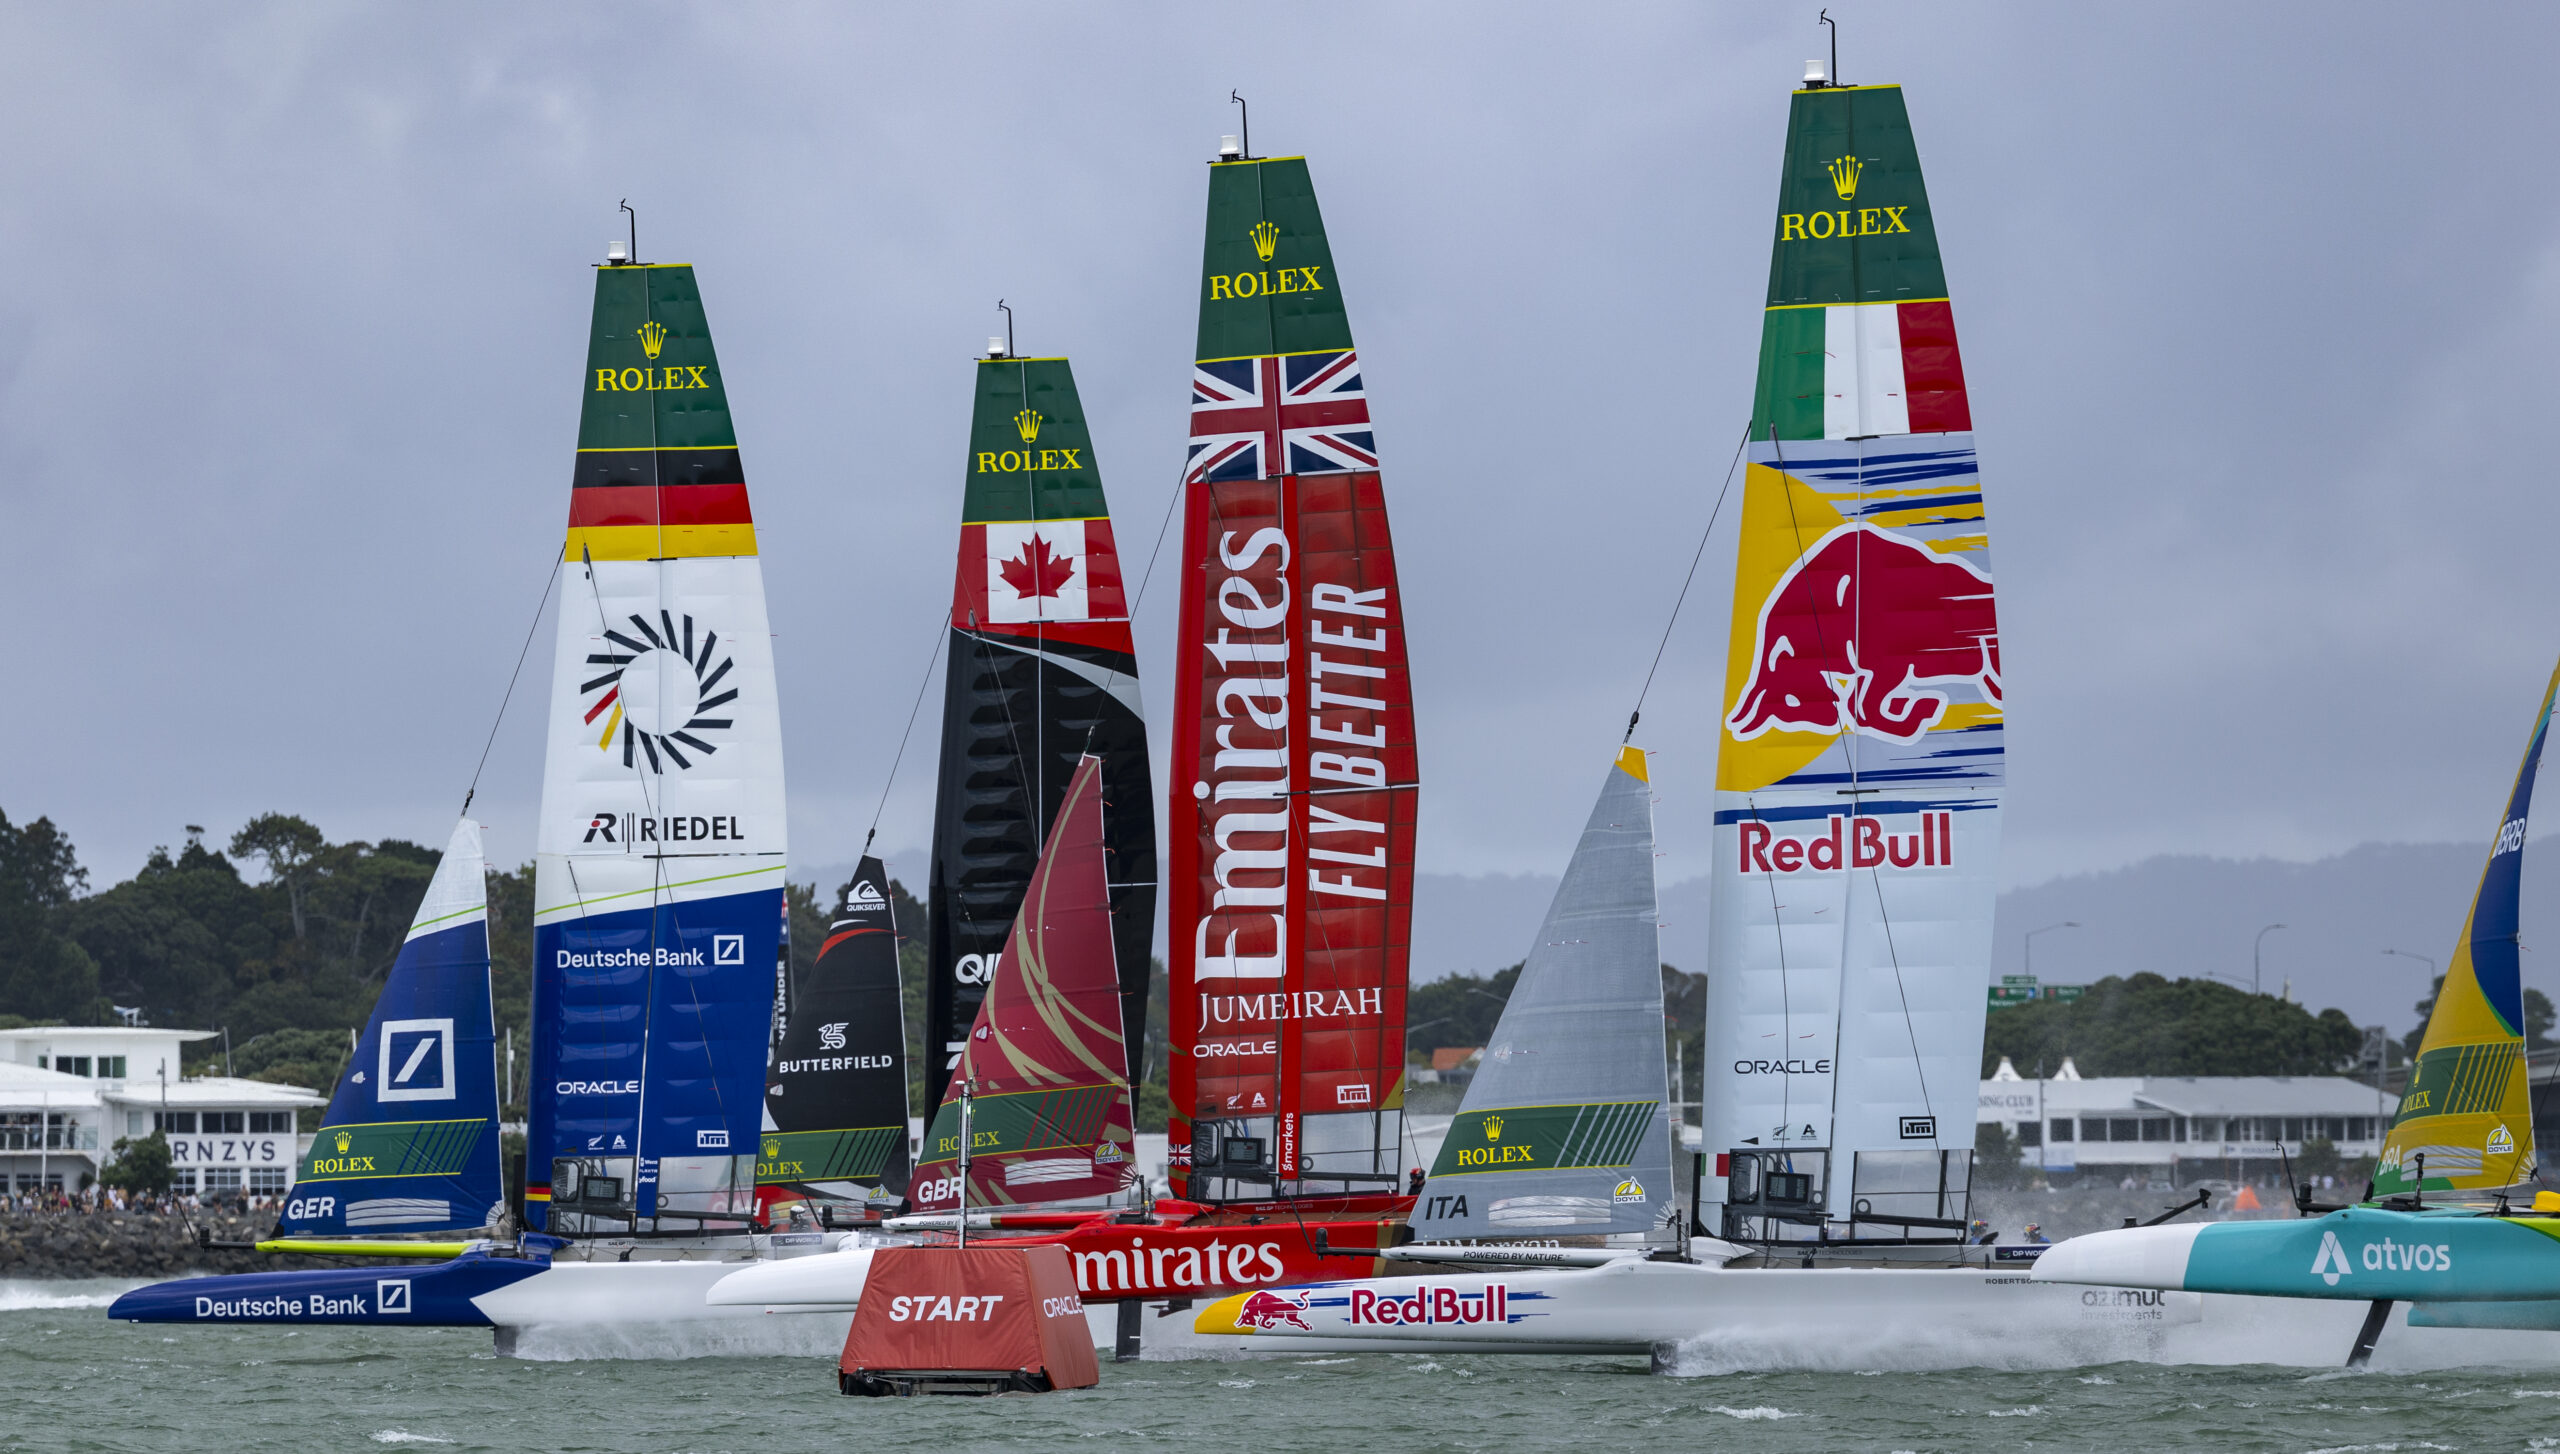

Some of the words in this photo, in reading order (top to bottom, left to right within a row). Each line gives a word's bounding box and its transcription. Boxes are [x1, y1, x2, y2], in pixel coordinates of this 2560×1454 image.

[1781, 206, 1910, 241] ROLEX
[1209, 266, 1323, 300] ROLEX
[595, 366, 709, 391] ROLEX
[976, 448, 1082, 473] ROLEX
[1309, 582, 1386, 787] BETTER
[1193, 526, 1291, 984] Emirates
[640, 816, 744, 841] RIEDEL
[1308, 804, 1387, 900] FLY
[1739, 816, 1843, 873] Red
[1852, 811, 1951, 868] Bull
[847, 903, 886, 911] QUIKSILVER
[557, 948, 650, 968] Deutsche
[656, 947, 704, 966] Bank
[1198, 987, 1383, 1033] JUMEIRAH
[1193, 1040, 1277, 1058] ORACLE
[779, 1055, 893, 1073] BUTTERFIELD
[1734, 1059, 1831, 1074] ORACLE
[556, 1080, 640, 1094] ORACLE
[173, 1141, 275, 1161] RNZYS
[938, 1131, 1000, 1152] ROEX
[313, 1156, 375, 1174] ROLEX
[1457, 1145, 1534, 1166] ROLEX
[2379, 1144, 2401, 1176] BRA
[743, 1161, 804, 1177] ROLEX
[918, 1176, 962, 1203] GBR
[288, 1196, 335, 1220] GER
[1425, 1194, 1469, 1220] ITA
[1057, 1237, 1284, 1291] mirates
[1463, 1251, 1510, 1260] POWERED
[1511, 1252, 1525, 1260] BY
[2363, 1236, 2451, 1271] atvos
[196, 1296, 302, 1317] Deutsche
[310, 1294, 367, 1315] Bank
[888, 1295, 1003, 1322] START
[1043, 1295, 1083, 1319] ORACLE
[1352, 1286, 1426, 1324] Red
[1434, 1285, 1505, 1324] Bull
